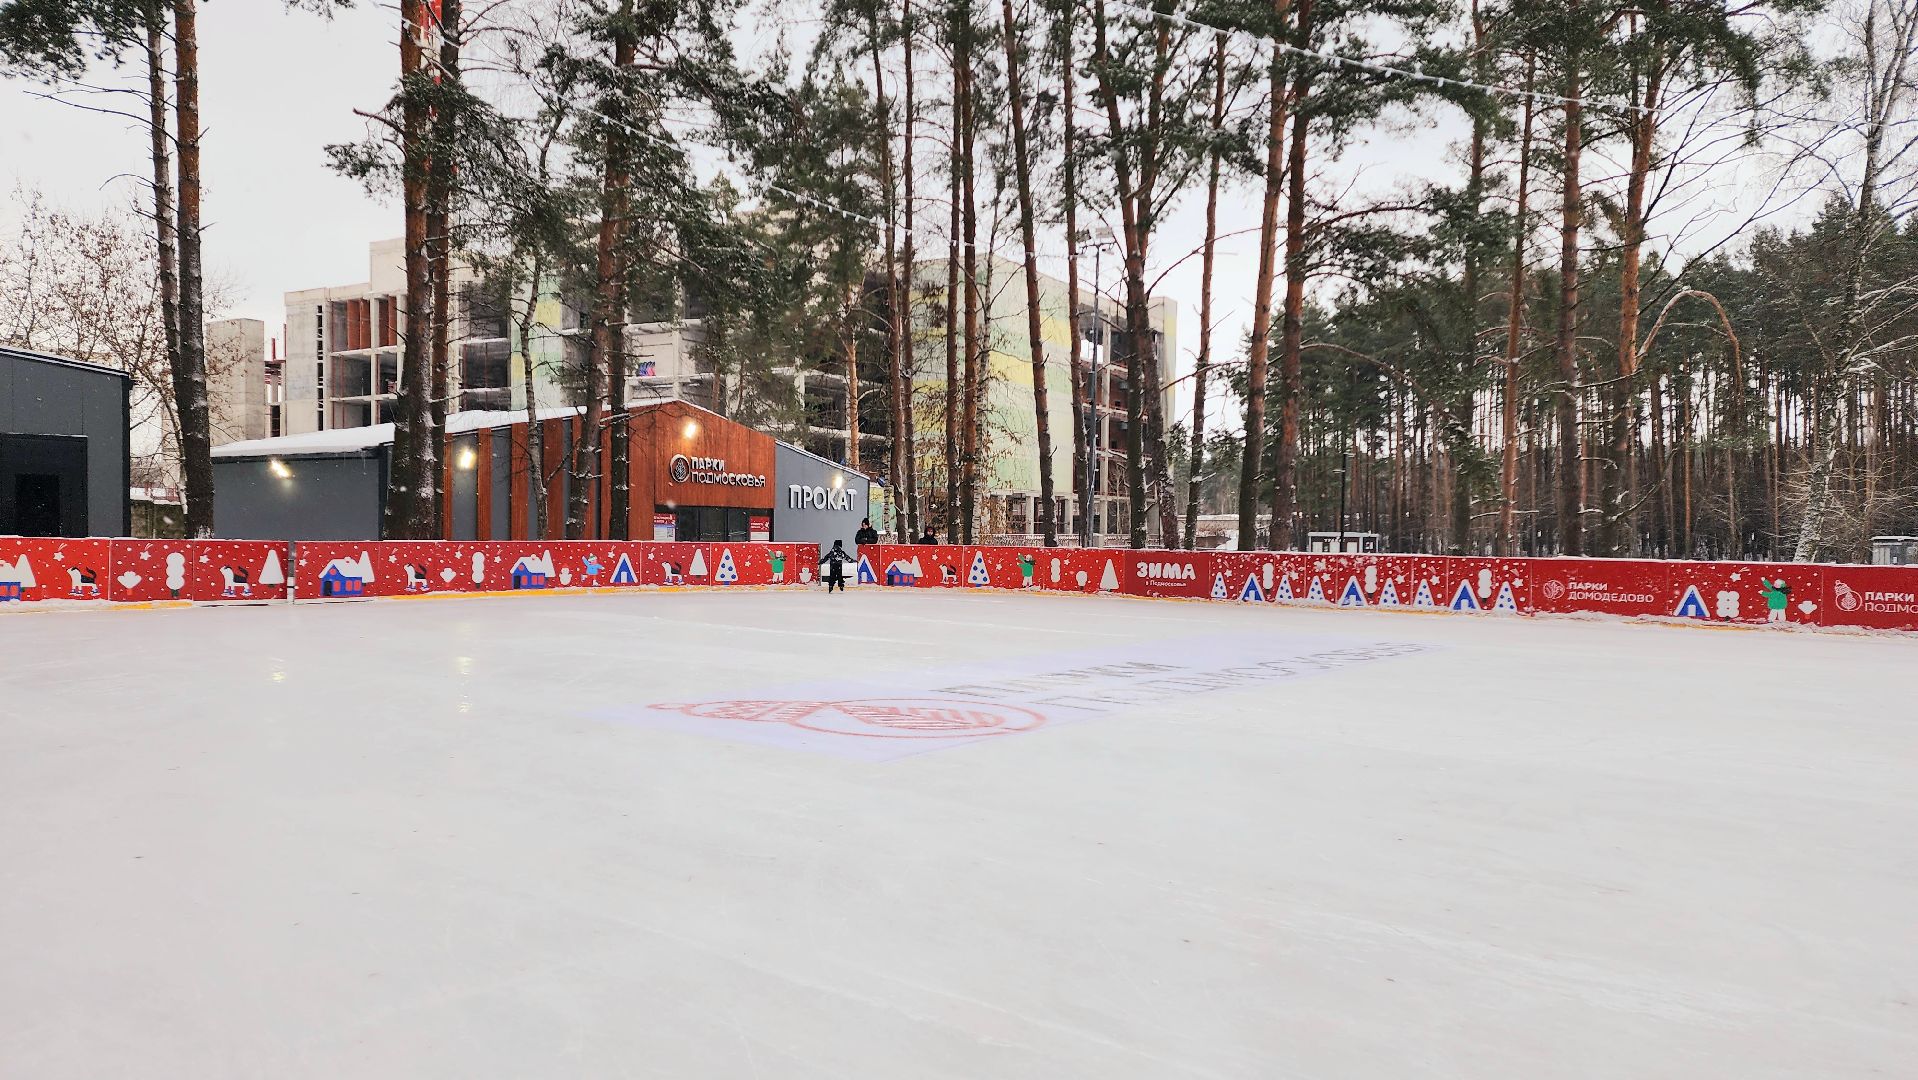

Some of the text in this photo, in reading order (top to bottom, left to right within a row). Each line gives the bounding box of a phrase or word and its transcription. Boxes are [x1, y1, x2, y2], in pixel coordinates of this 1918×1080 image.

[690, 456, 725, 472] ПАРКИ
[690, 471, 766, 488] ПОДМОСКОВЬЯ
[788, 484, 858, 511] ПРОКАТ
[1136, 561, 1196, 580] ЗИМА
[1567, 581, 1608, 591] ПАРКИ
[1567, 591, 1654, 603] ДОМОДЕДОВО
[1864, 591, 1915, 603] ПАРКИ
